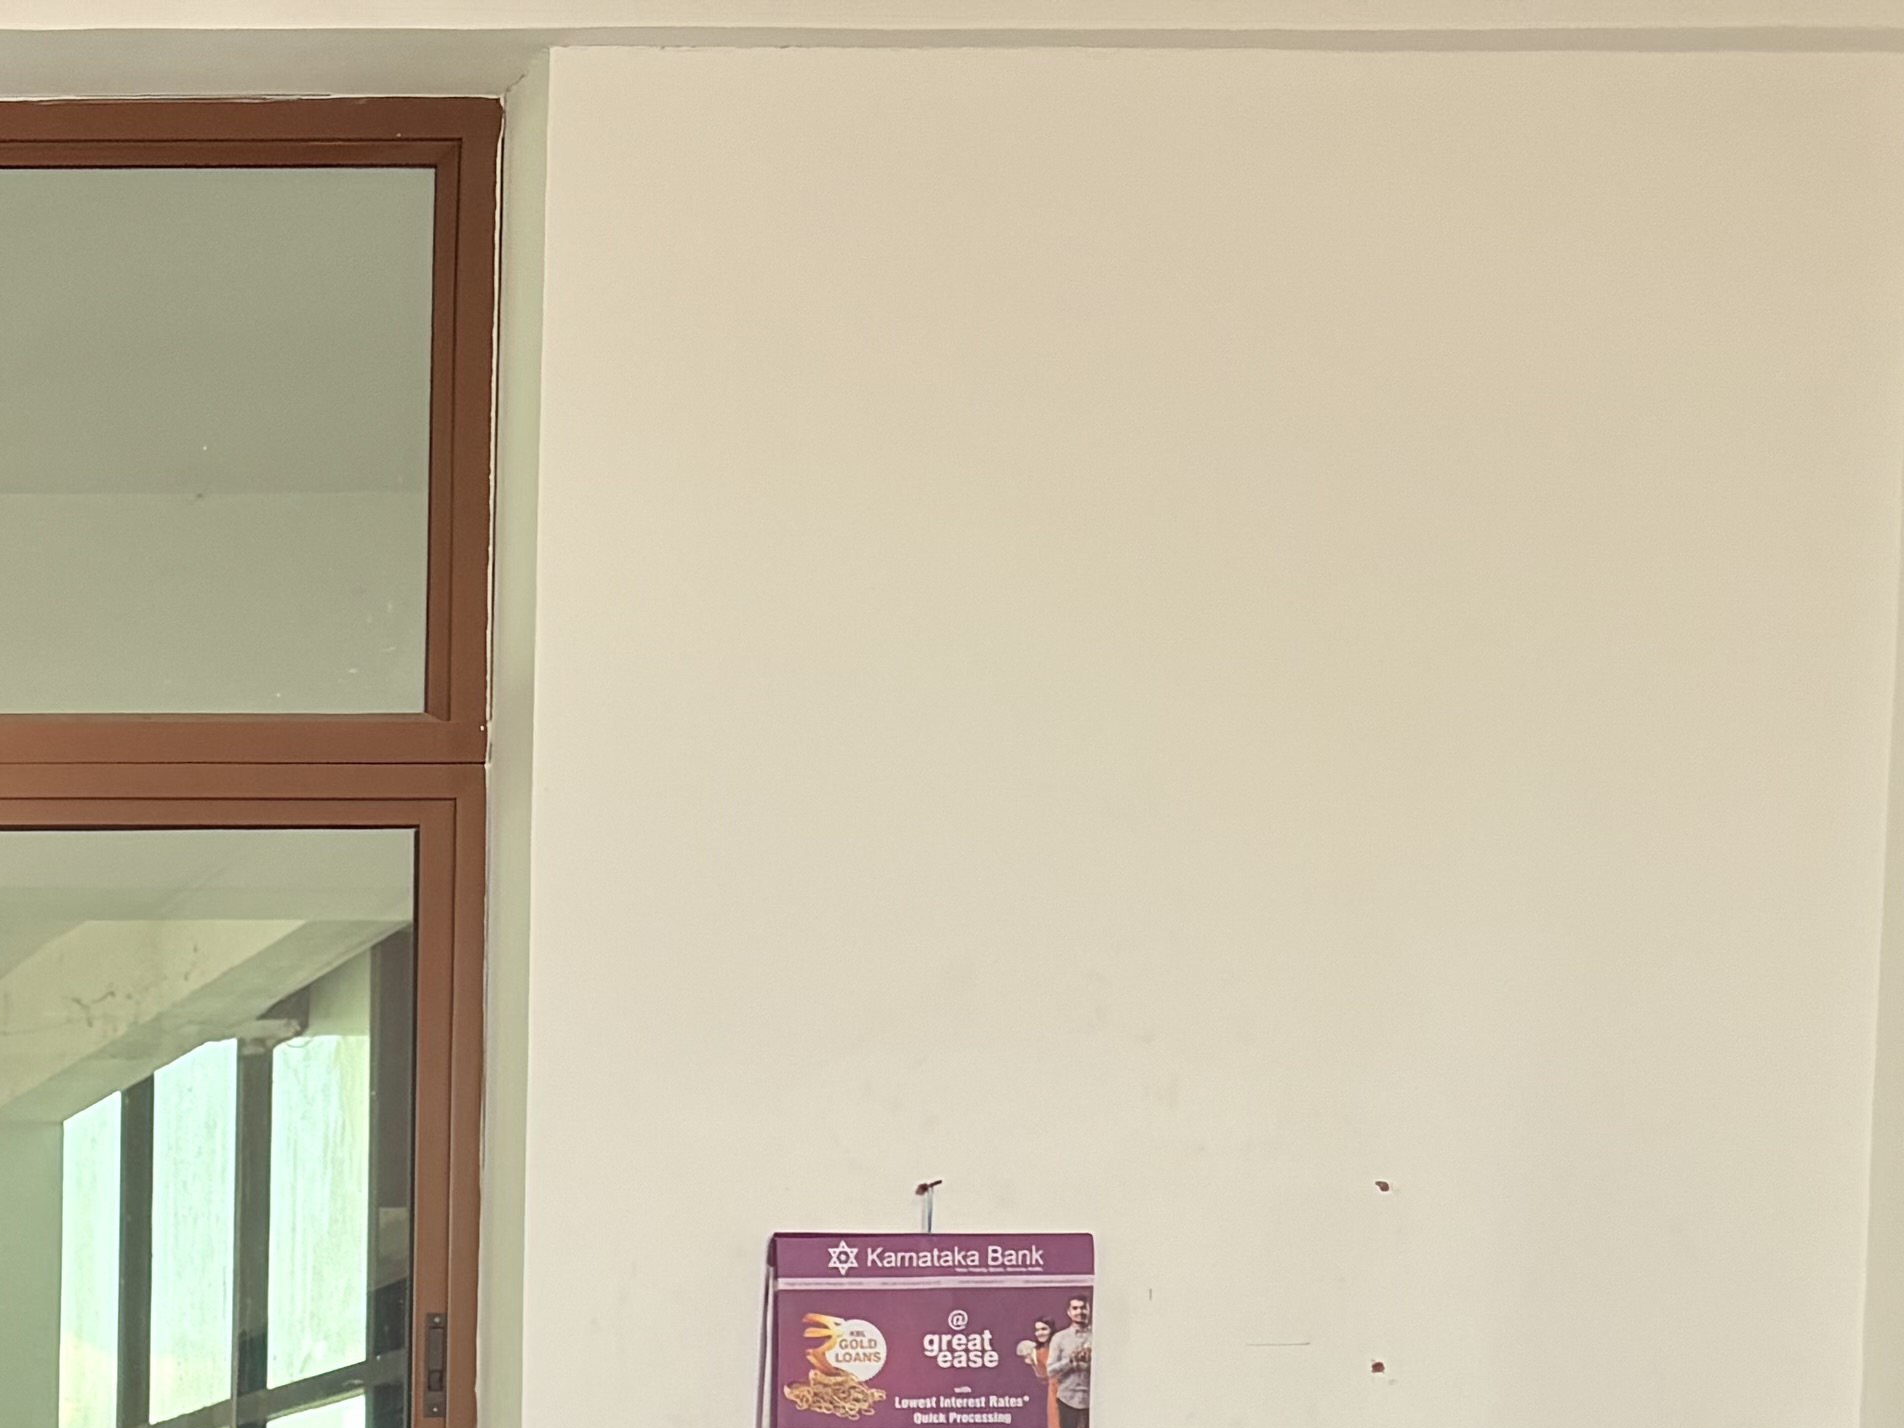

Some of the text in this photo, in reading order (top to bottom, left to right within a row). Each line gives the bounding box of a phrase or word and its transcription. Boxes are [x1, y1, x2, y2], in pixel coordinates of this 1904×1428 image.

[867, 1245, 1044, 1267] Karnataka Bank
[948, 1310, 968, 1330] @
[839, 1339, 877, 1349] GOLD
[923, 1330, 992, 1356] great
[835, 1352, 881, 1363] LOANS
[937, 1350, 999, 1368] ease
[895, 1396, 936, 1408] Lowest
[940, 1396, 986, 1408] Interest
[913, 1412, 1011, 1424] Quick Processing
